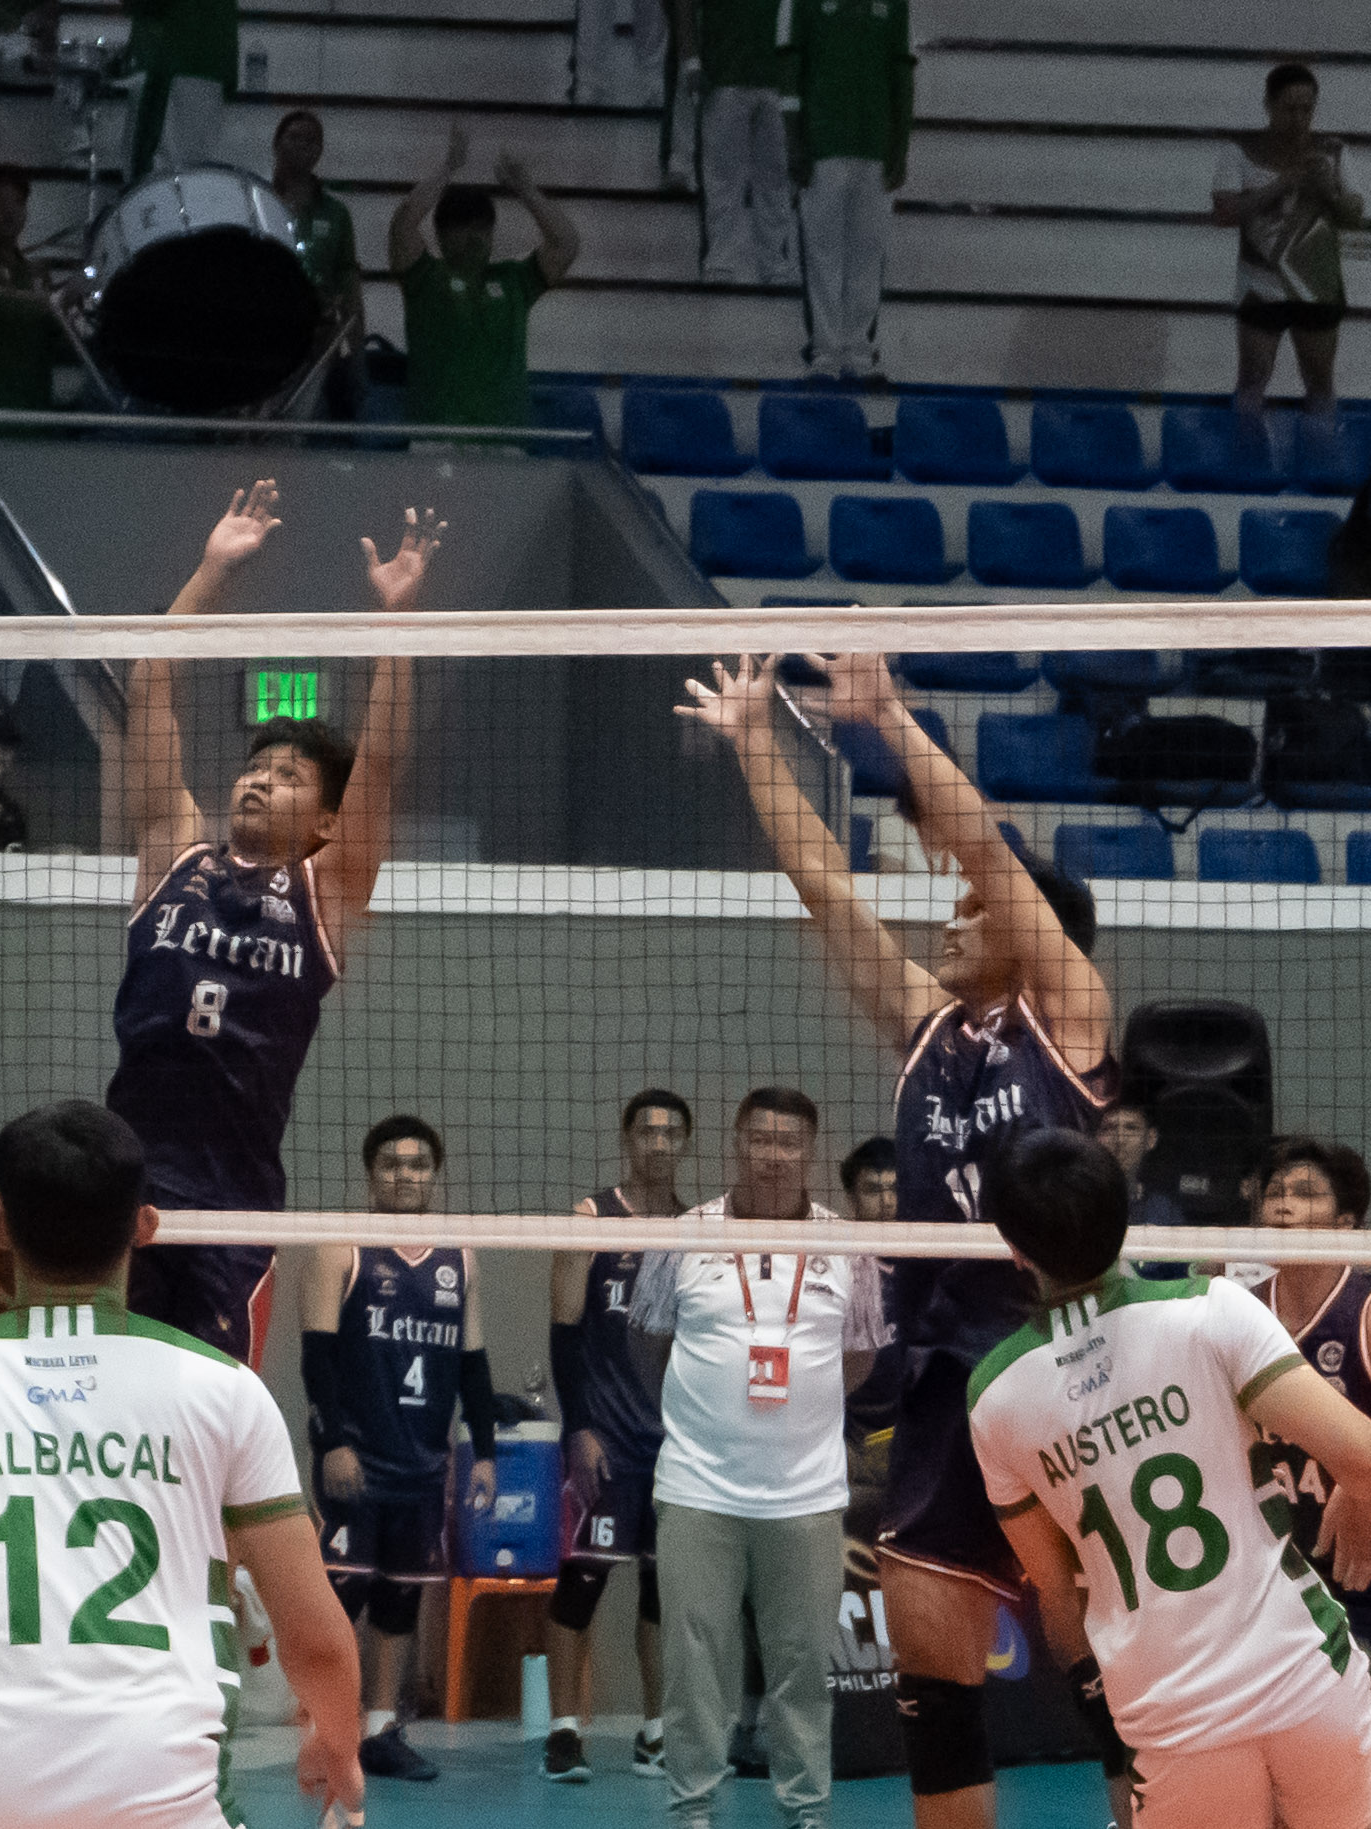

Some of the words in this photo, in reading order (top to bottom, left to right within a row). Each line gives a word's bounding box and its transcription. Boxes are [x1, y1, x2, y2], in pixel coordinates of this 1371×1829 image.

[150, 903, 304, 978] Letran
[186, 980, 228, 1037] 8
[366, 1304, 459, 1347] Letran
[28, 1386, 87, 1404] GMA
[403, 1355, 425, 1397] 4
[1038, 1384, 1190, 1488] AUSTERO
[329, 1525, 348, 1556] 4
[590, 1515, 615, 1547] 16
[1077, 1452, 1230, 1613] 18
